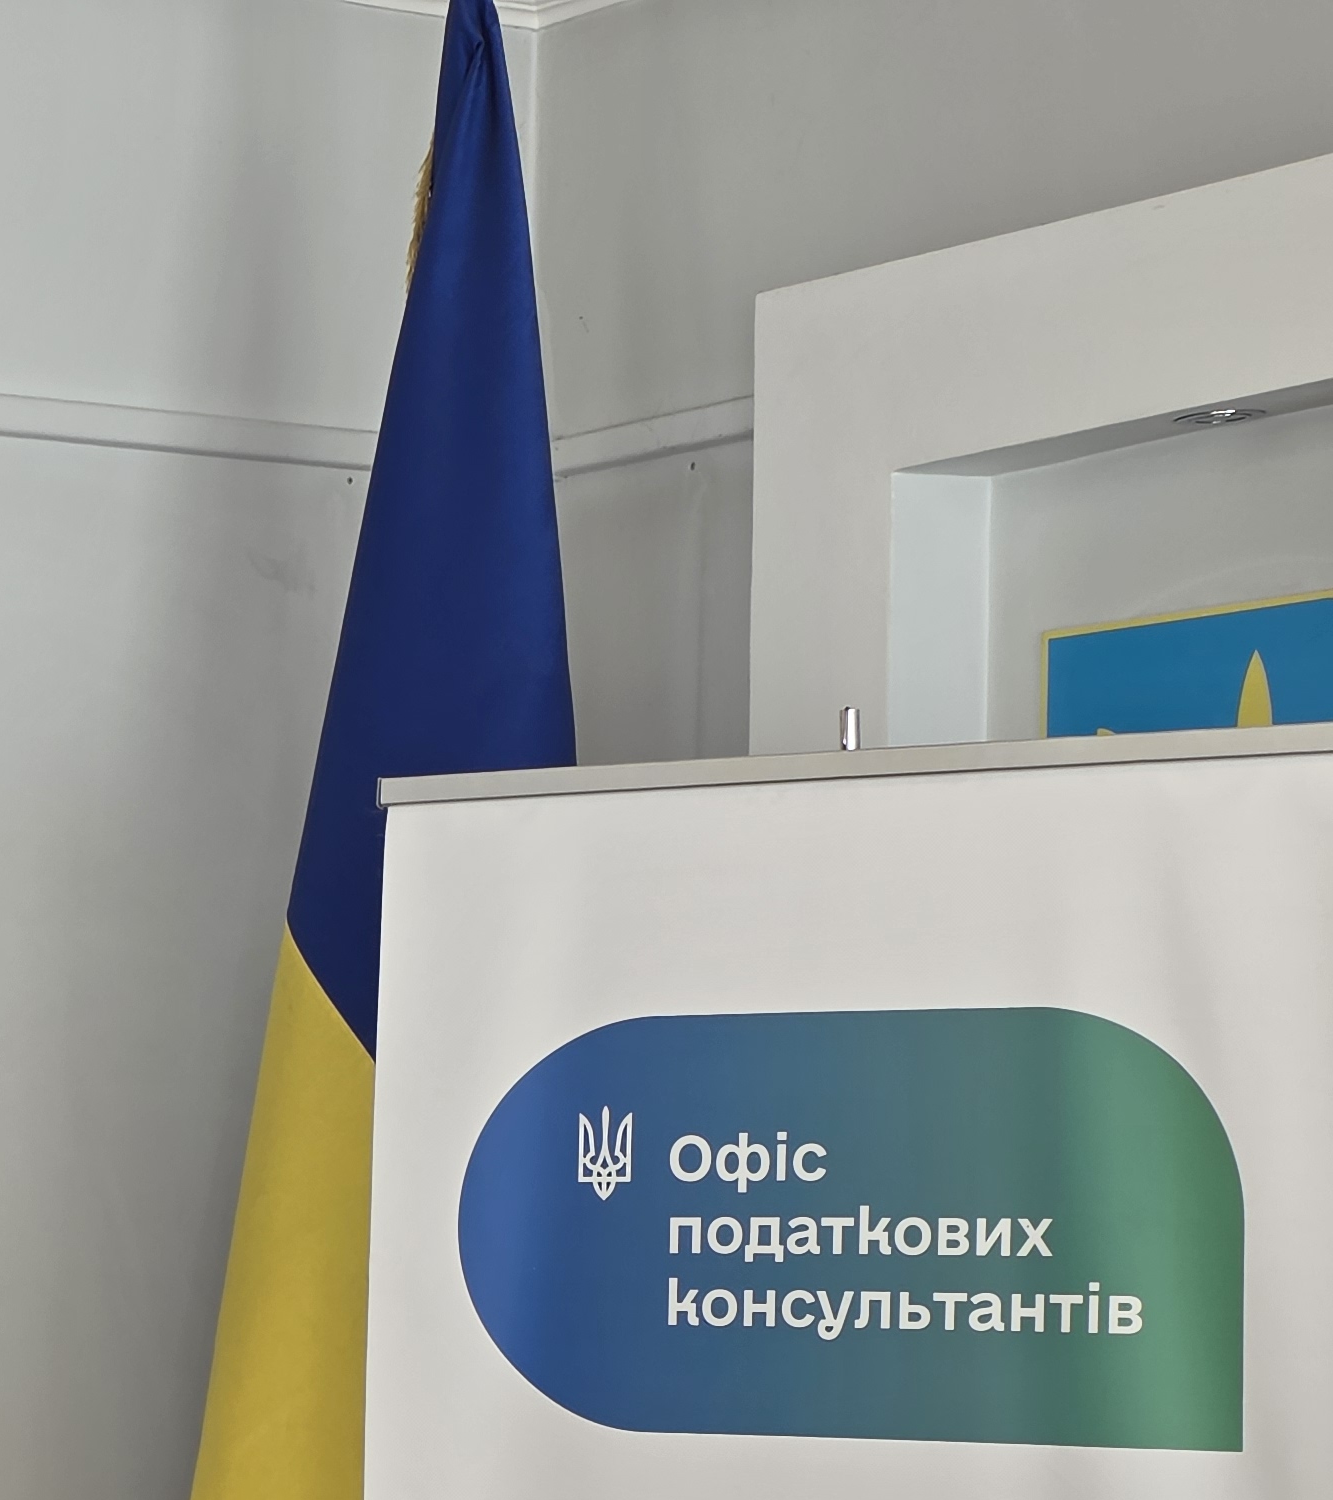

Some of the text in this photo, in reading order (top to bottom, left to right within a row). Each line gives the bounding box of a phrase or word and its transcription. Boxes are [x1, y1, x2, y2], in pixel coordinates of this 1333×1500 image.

[668, 1132, 827, 1194] Офіс
[668, 1205, 1053, 1262] податкових
[666, 1278, 1143, 1340] консультантів
